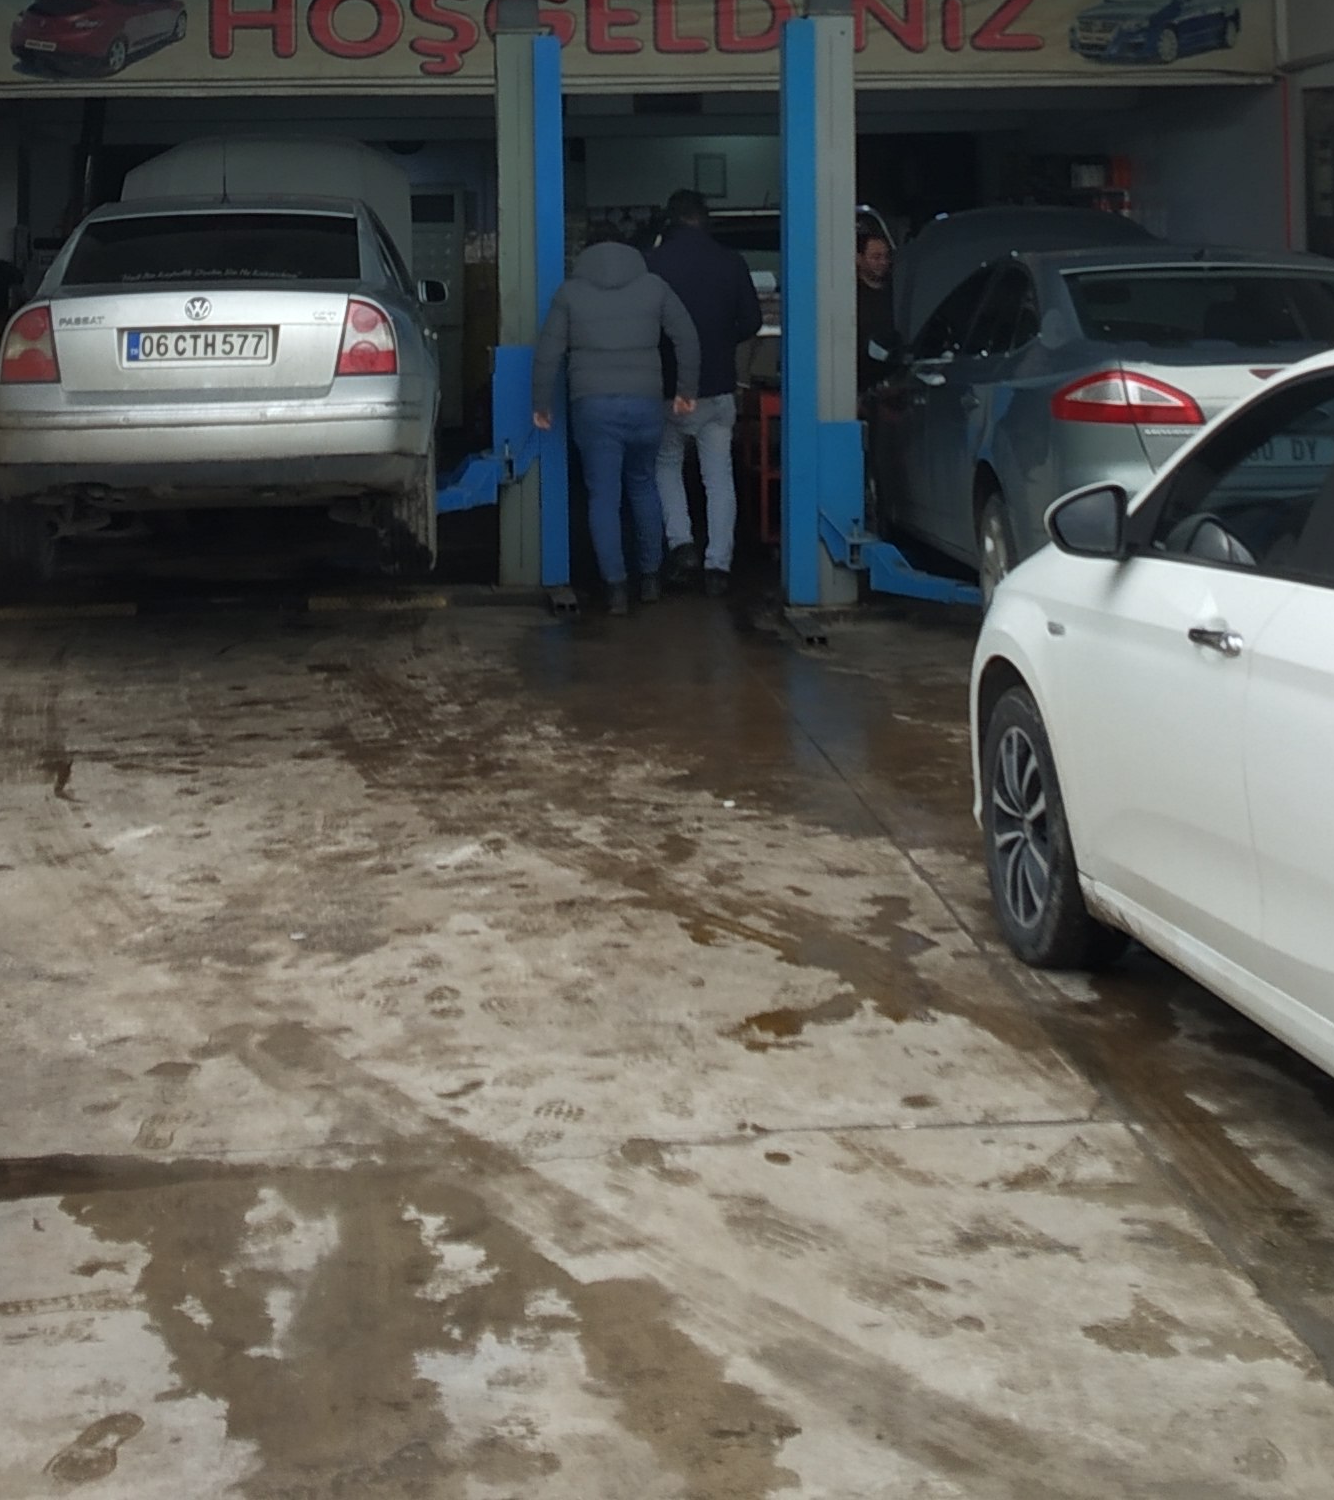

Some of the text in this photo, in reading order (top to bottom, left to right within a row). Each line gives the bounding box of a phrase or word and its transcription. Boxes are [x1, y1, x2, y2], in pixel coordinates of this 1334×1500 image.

[141, 335, 168, 357] 06
[174, 334, 216, 356] CTH
[221, 333, 264, 356] 577
